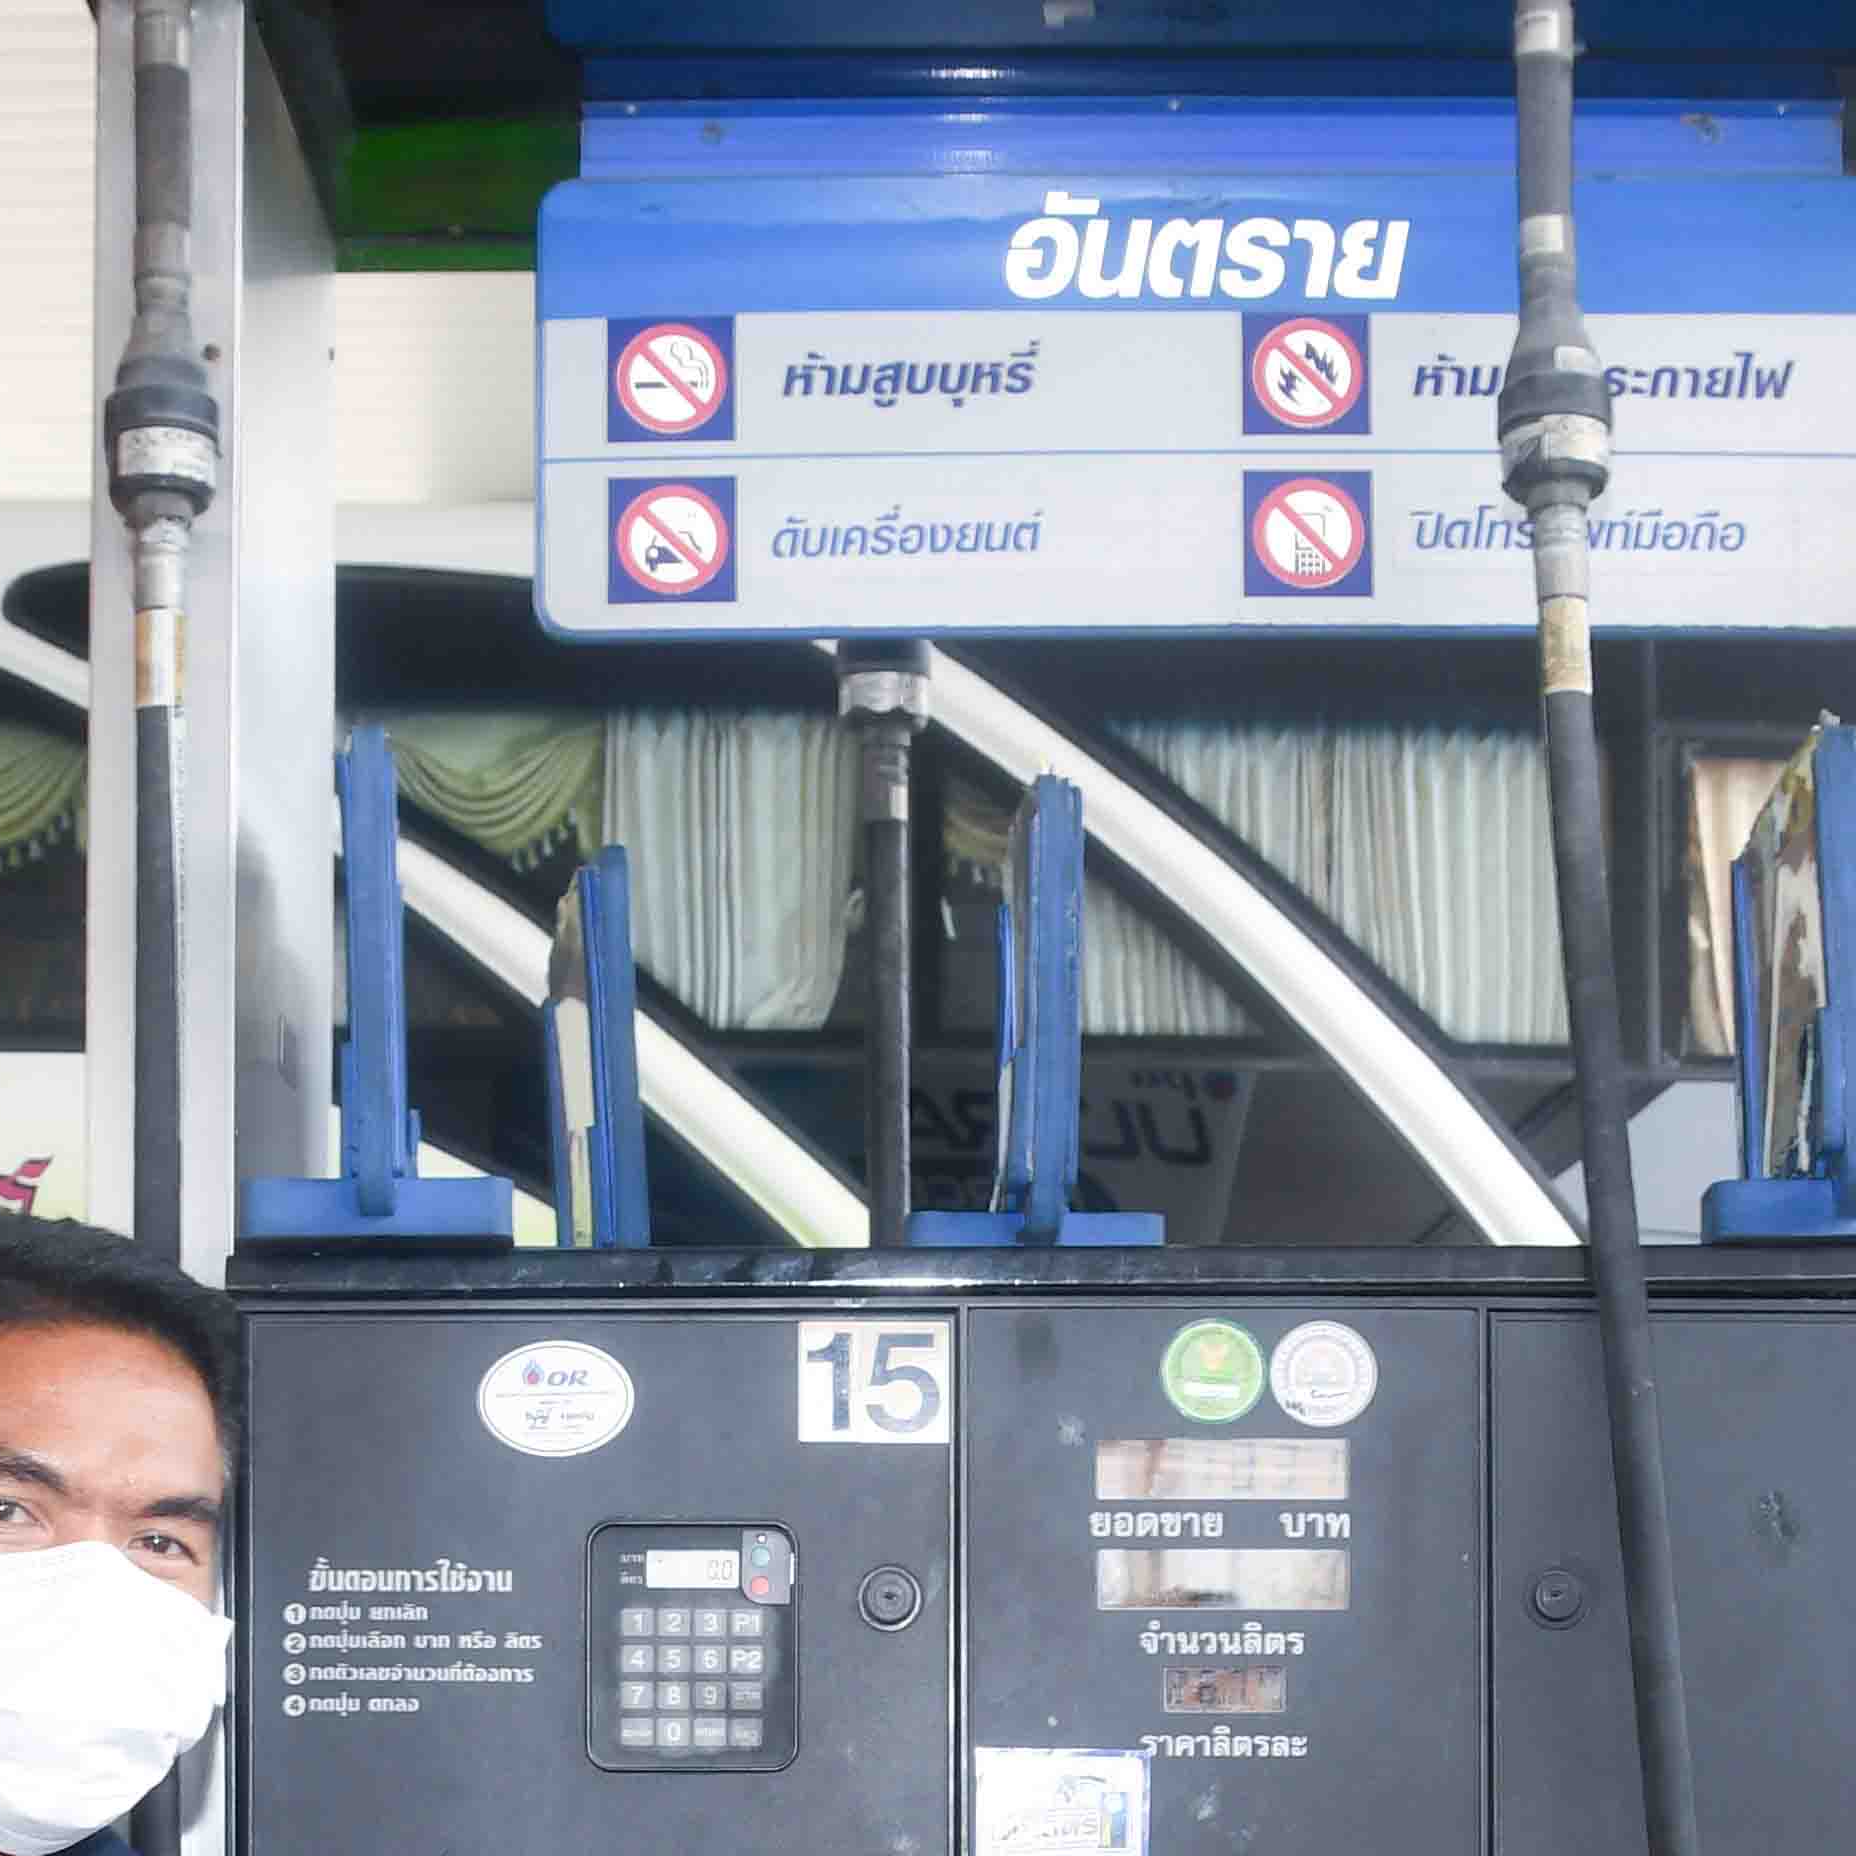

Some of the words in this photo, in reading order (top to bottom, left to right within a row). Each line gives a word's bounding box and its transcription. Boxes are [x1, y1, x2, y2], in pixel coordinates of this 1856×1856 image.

[1006, 191, 1410, 301] อันตราย
[783, 340, 1038, 408] ห้ามสูบบุหรี่
[1413, 352, 1794, 404] ห้ามระกายไฟ
[772, 511, 1041, 560] ดับเครื่องยนต์
[1412, 502, 1746, 562] ปิดโทรพท์มือถือ
[806, 1331, 941, 1433] 15
[1088, 1511, 1224, 1538] ยอดขาย
[1278, 1511, 1351, 1539] บาท
[308, 1556, 514, 1594] ขั้นตอนการใช้งาน
[1138, 1619, 1305, 1656] จำนวนลิตร
[1139, 1725, 1308, 1758] ราคาลิตรละ
